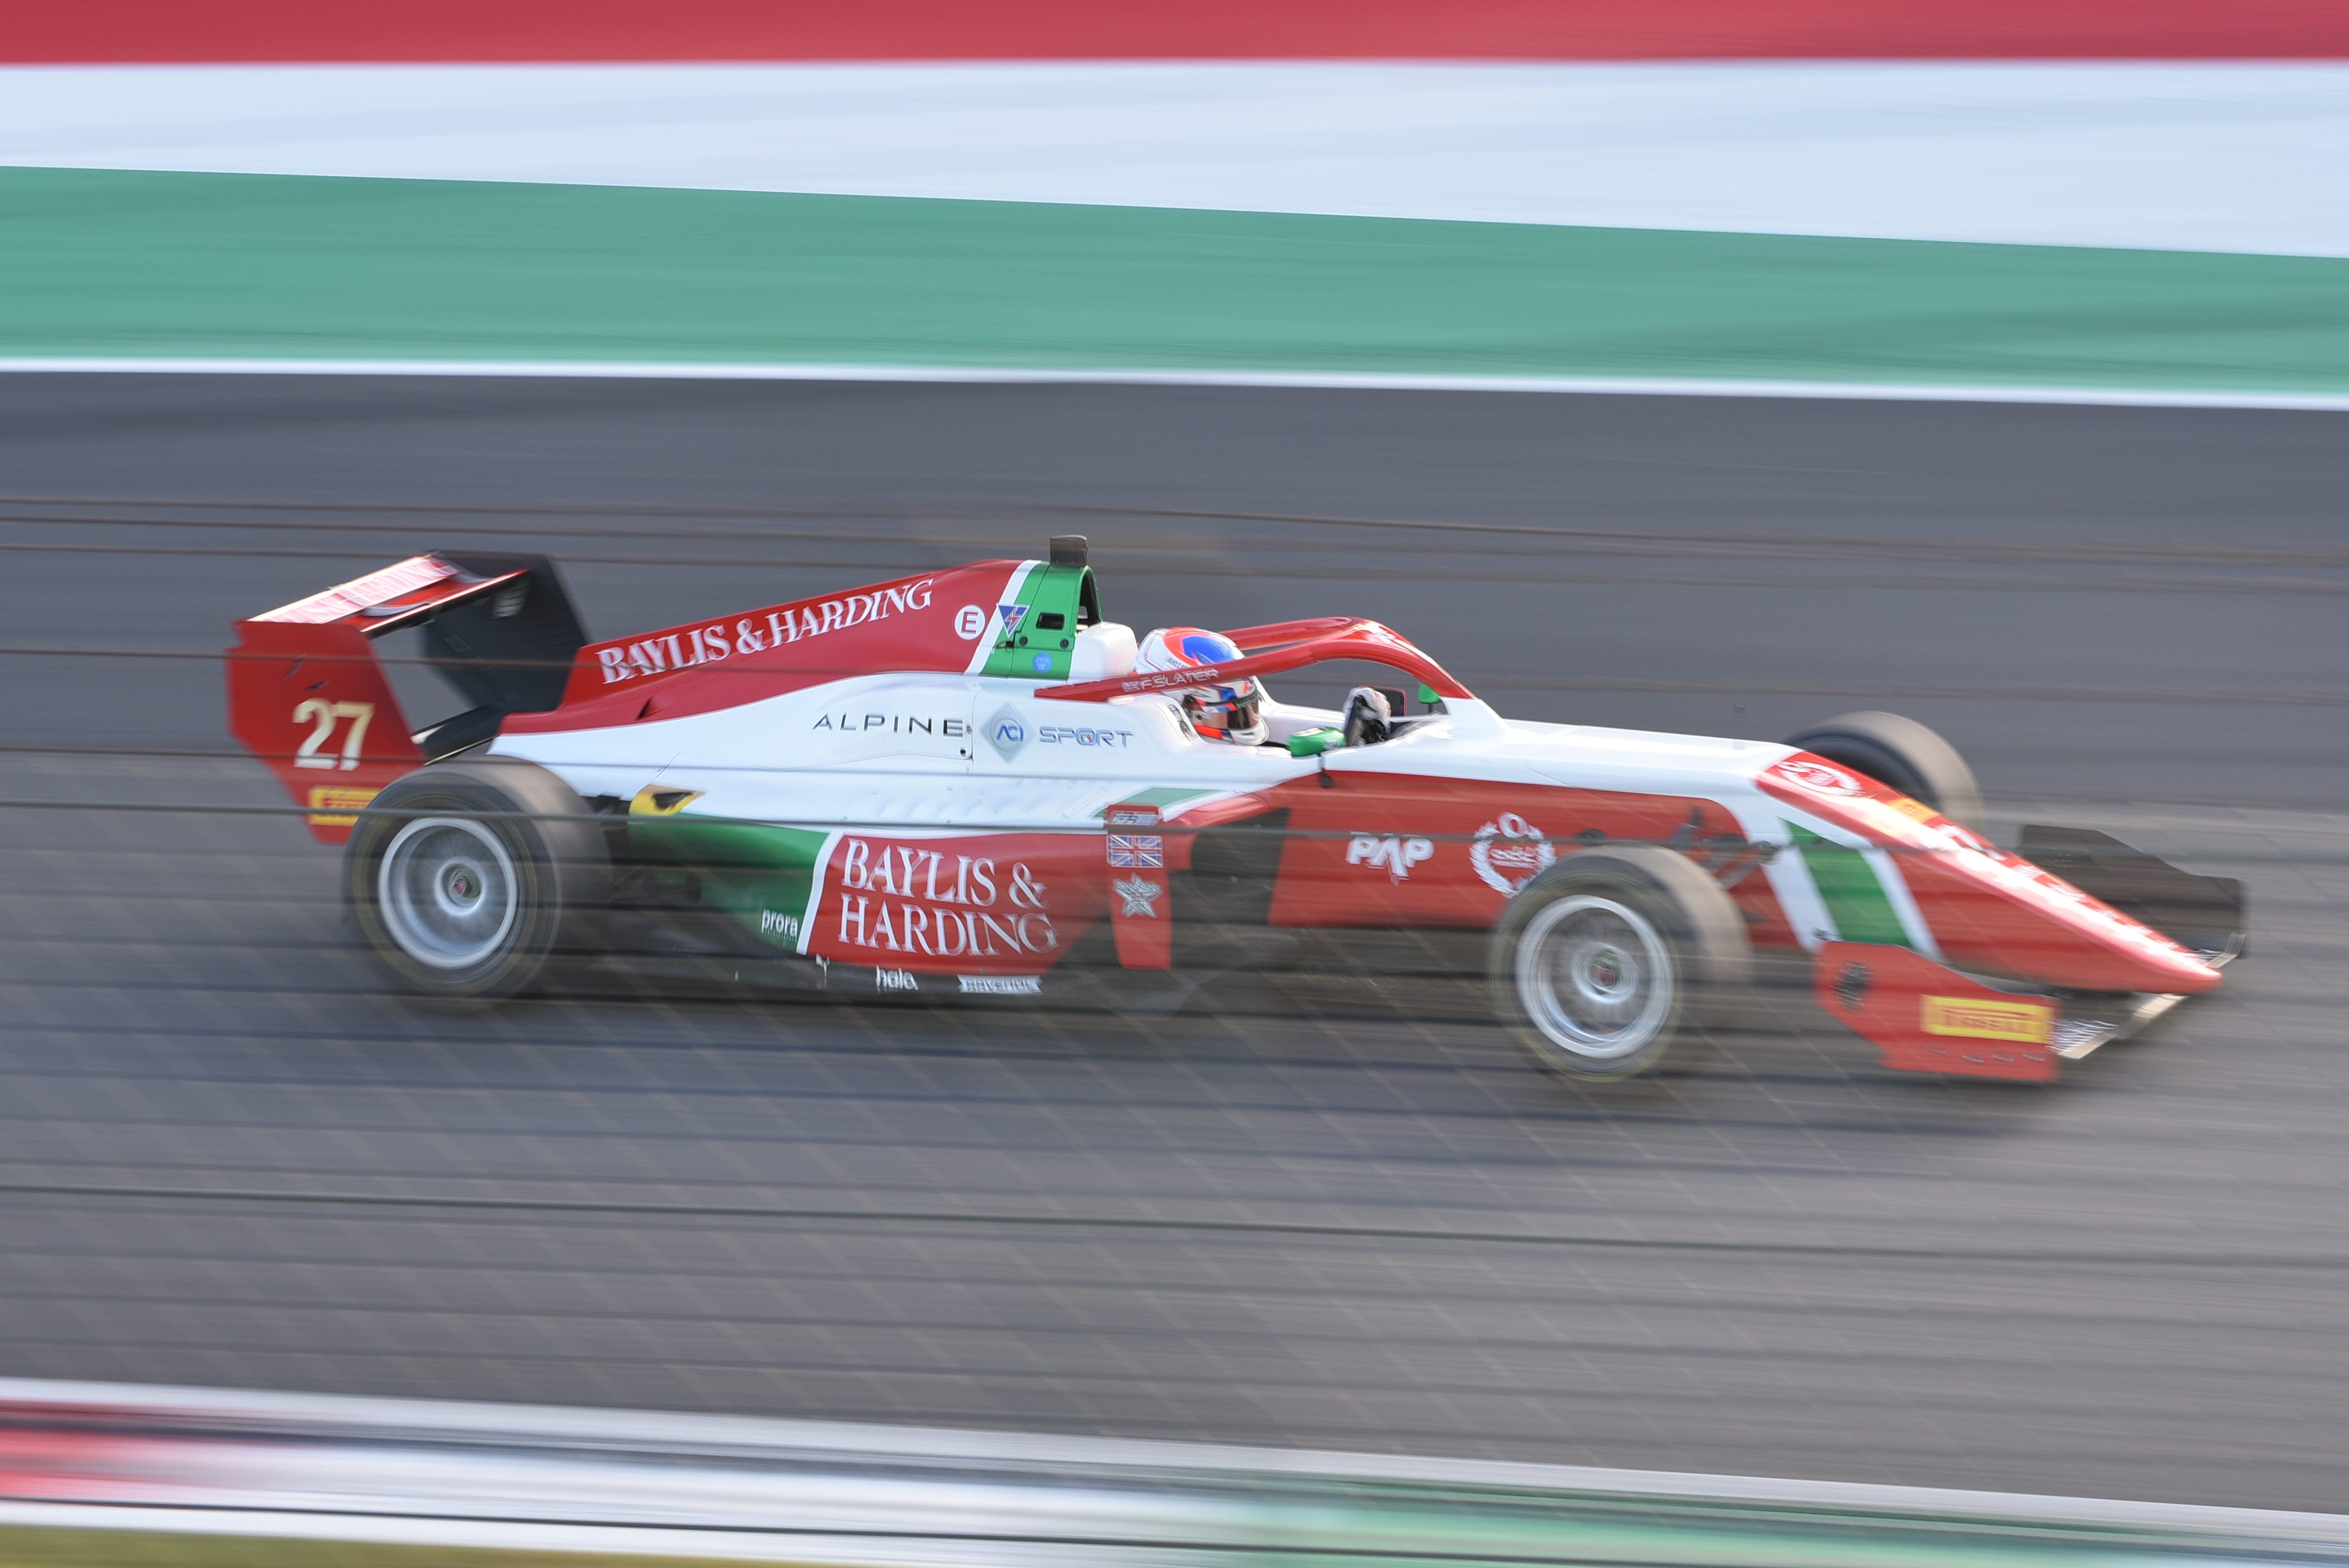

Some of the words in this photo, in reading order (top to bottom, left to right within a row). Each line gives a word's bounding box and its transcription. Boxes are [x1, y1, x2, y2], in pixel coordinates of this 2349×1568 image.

[595, 624, 731, 684] BAYLIS
[736, 618, 767, 655] &
[765, 578, 934, 648] HARDING
[960, 611, 978, 635] E
[292, 697, 376, 771] 27
[811, 712, 964, 737] ALPINE
[1039, 726, 1134, 748] SPORT
[841, 838, 997, 907] BAYLIS
[1008, 862, 1052, 909] &
[761, 908, 798, 937] prora
[838, 893, 1059, 956] HARDING
